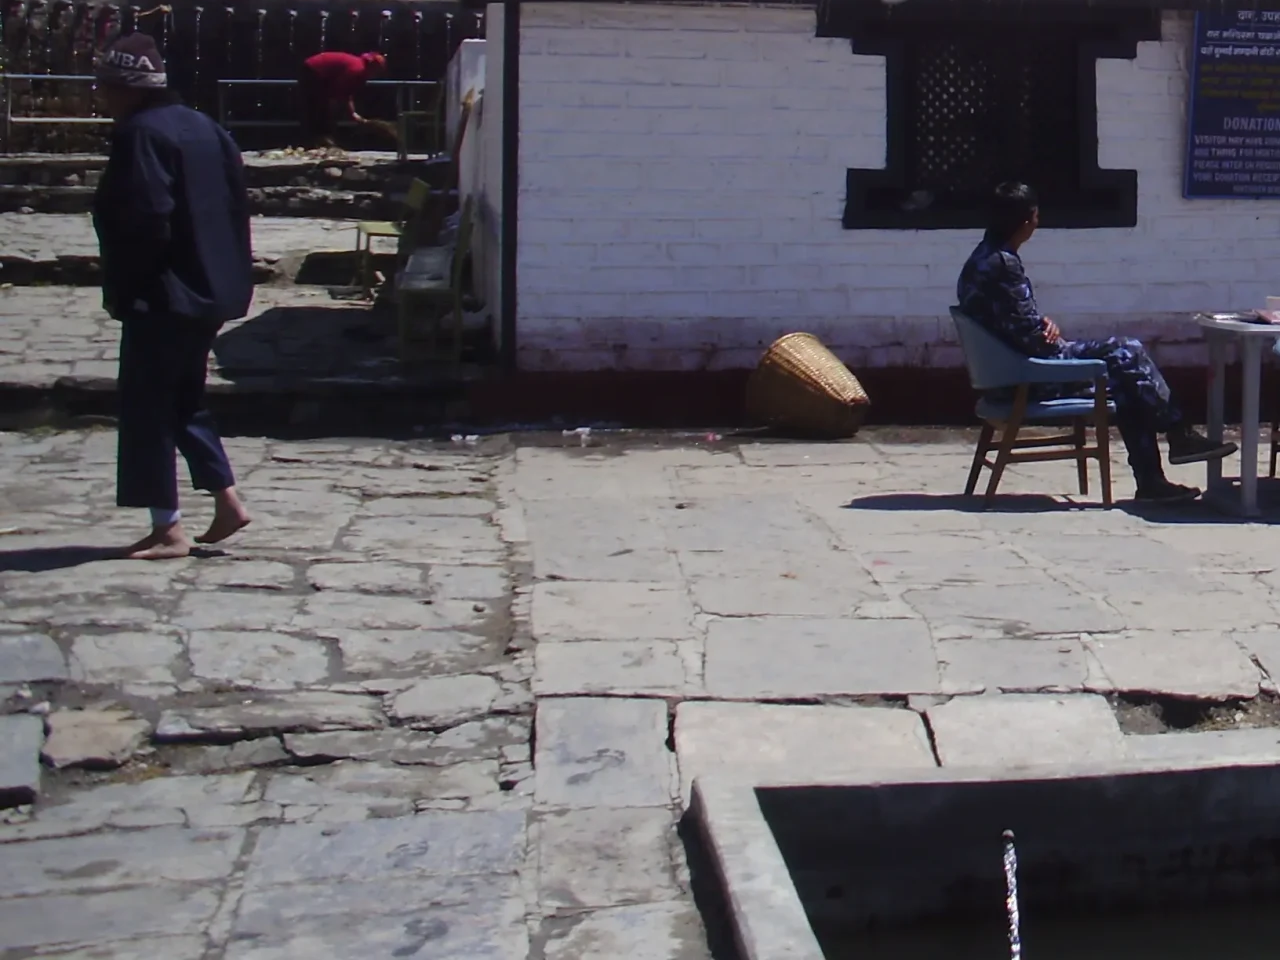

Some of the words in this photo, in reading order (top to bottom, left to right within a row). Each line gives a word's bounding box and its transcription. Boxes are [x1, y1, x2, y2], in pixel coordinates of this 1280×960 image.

[107, 50, 156, 71] NBA
[1194, 135, 1226, 145] VISITOR
[1228, 136, 1243, 145] MAY
[1239, 148, 1253, 158] FOR
[1193, 160, 1220, 170] PLEASE
[1193, 172, 1213, 182] YOUR
[1215, 172, 1251, 182] DONATION
